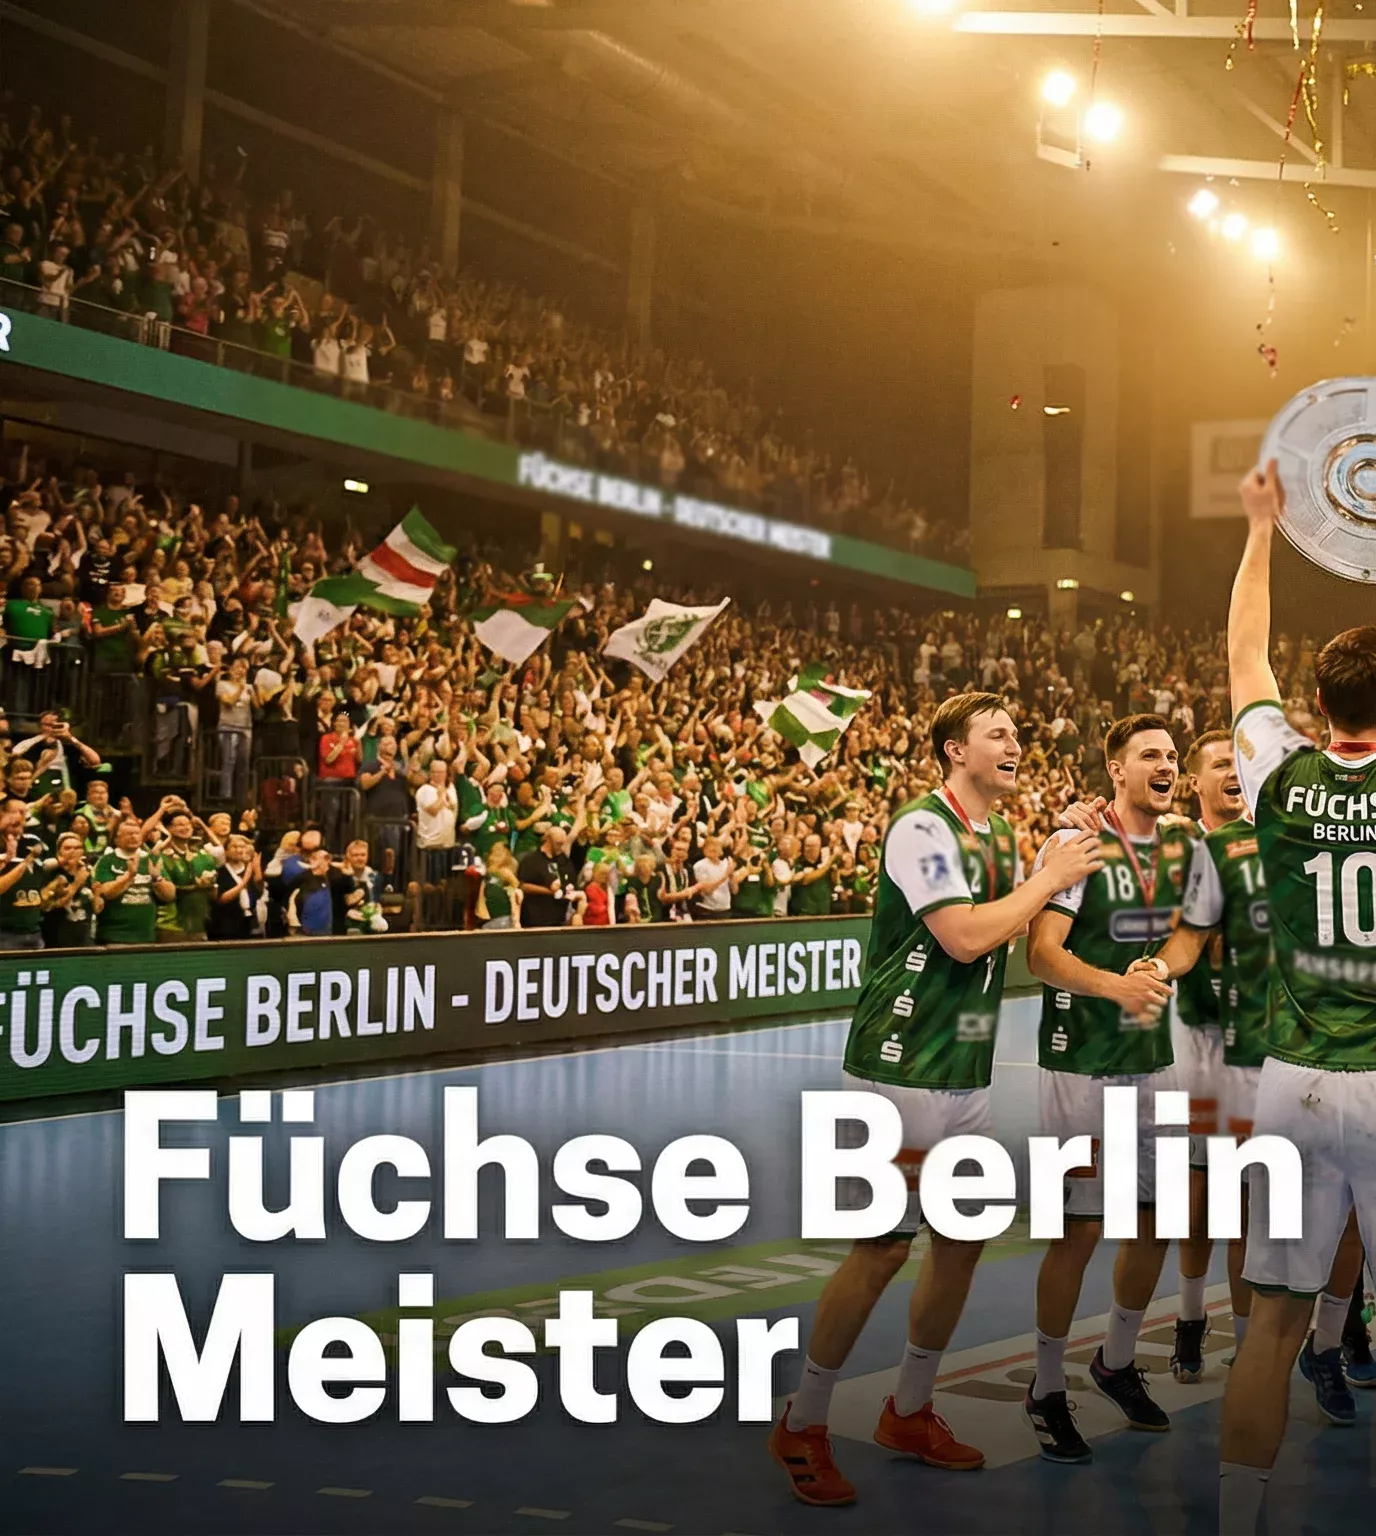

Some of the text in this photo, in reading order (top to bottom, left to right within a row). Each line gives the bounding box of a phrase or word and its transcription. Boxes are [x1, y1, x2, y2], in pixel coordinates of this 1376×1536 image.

[1102, 865, 1134, 901] 18
[0, 970, 227, 1068] ÜCHSE
[246, 964, 436, 1047] BERLIN
[485, 947, 718, 1024] DEUTSCHER
[728, 939, 862, 1000] MEISTER
